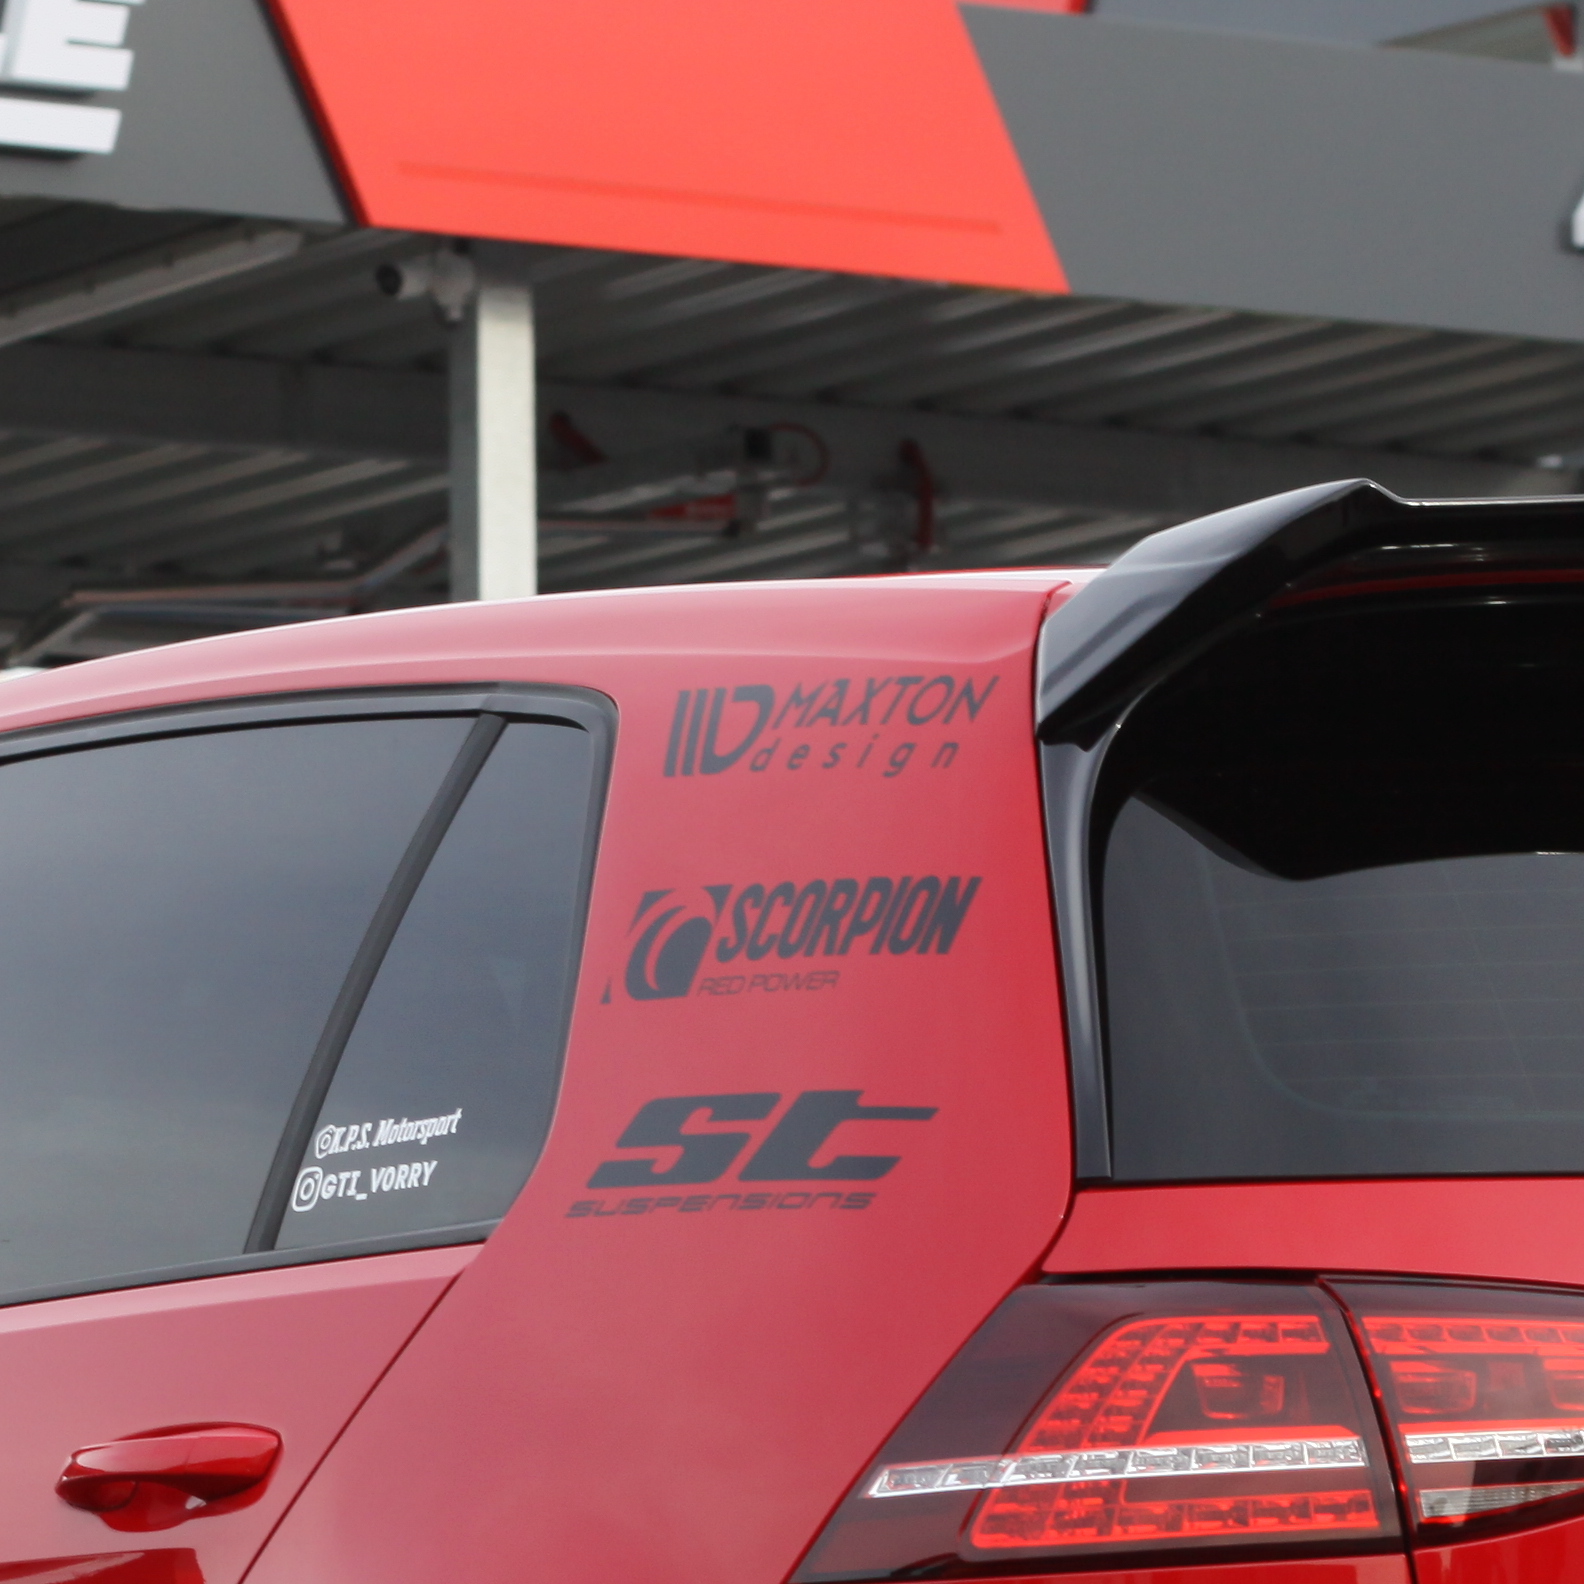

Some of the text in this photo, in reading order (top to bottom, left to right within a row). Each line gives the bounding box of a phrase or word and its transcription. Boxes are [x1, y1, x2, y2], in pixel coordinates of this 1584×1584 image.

[771, 674, 1000, 730] MAXTON
[749, 732, 960, 778] design
[716, 875, 983, 963] SCORPION
[697, 969, 840, 997] RED POWER
[372, 1107, 463, 1147] Motorsport
